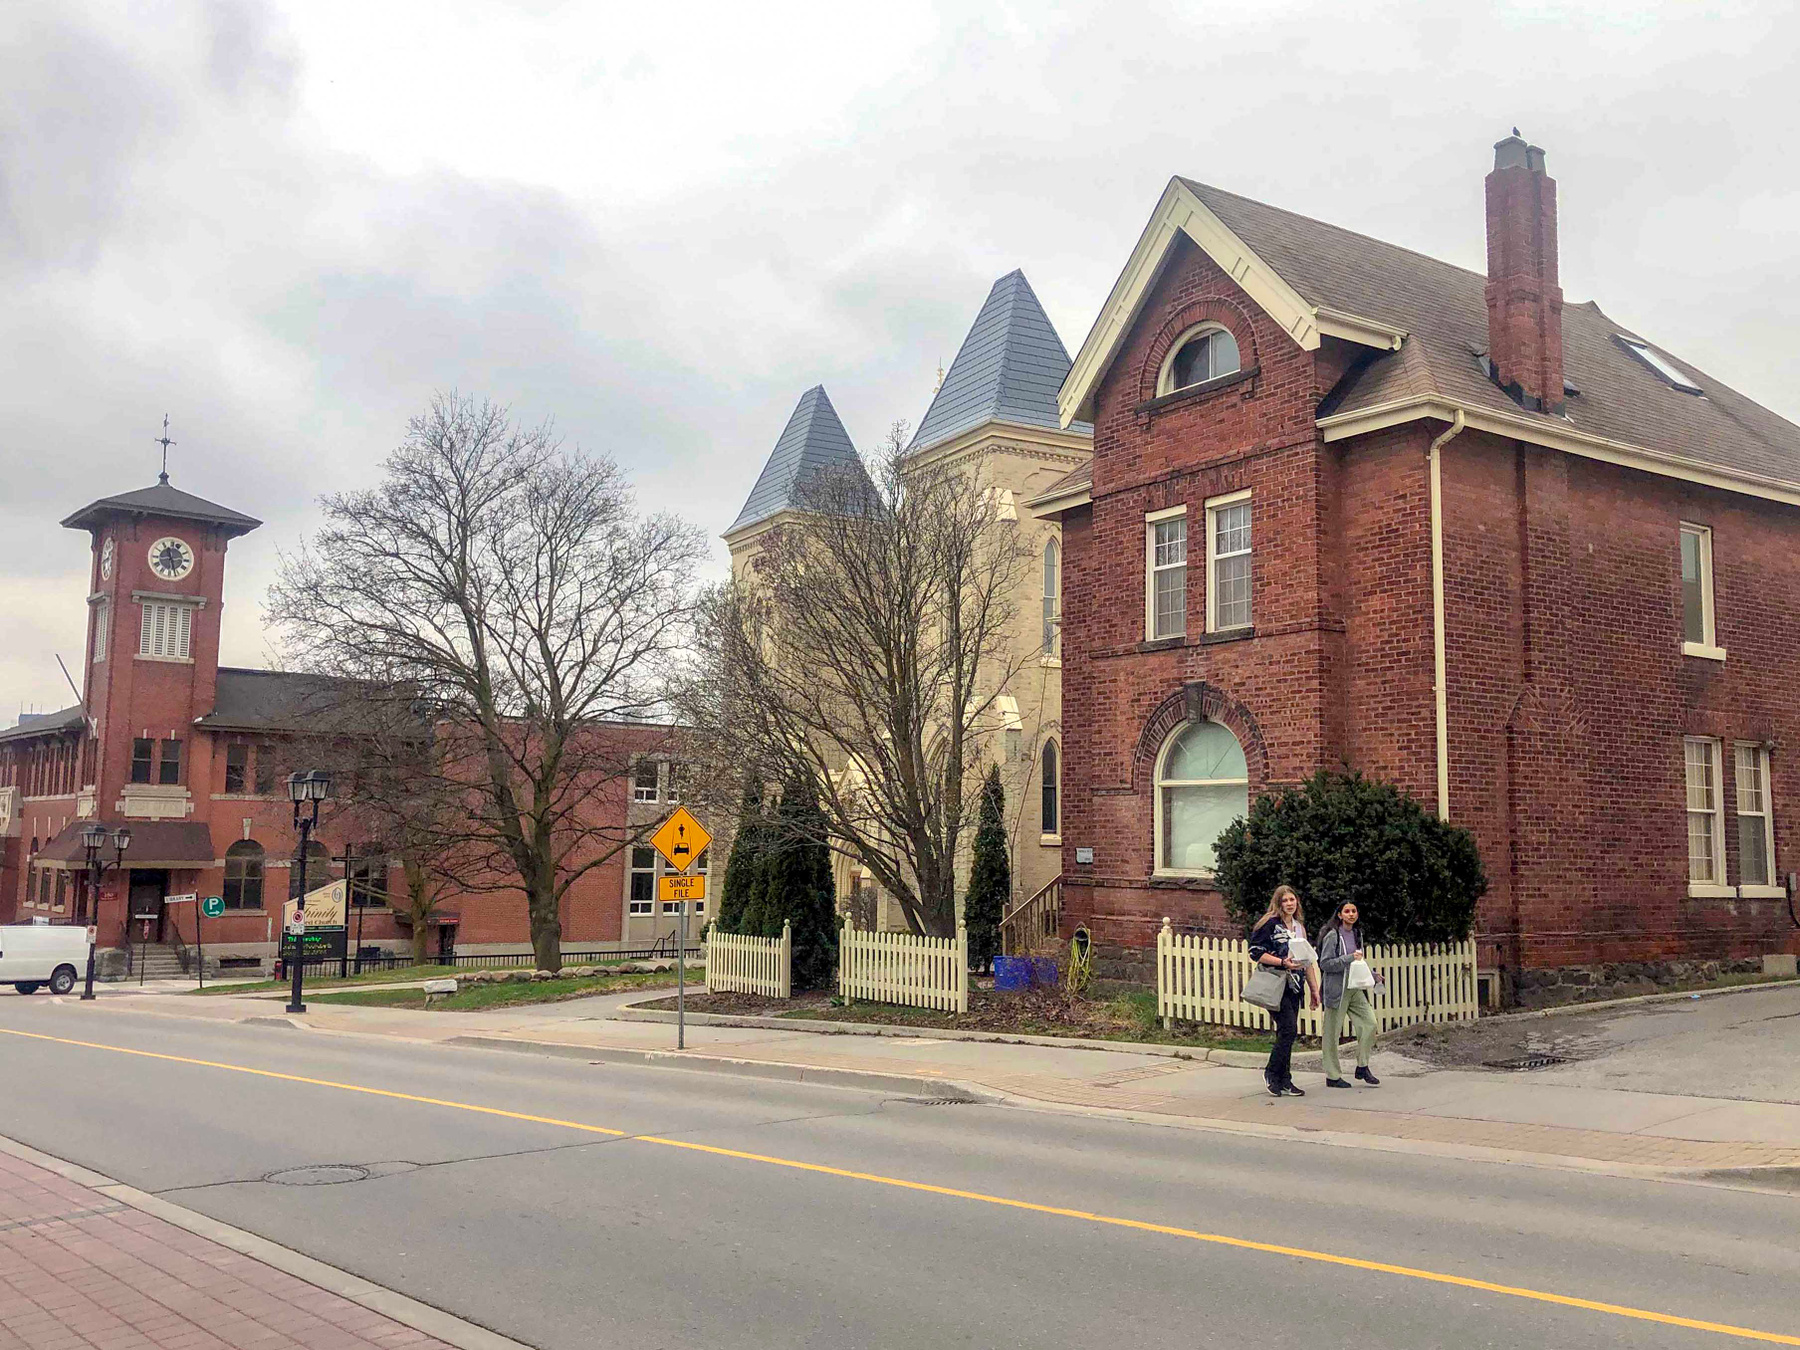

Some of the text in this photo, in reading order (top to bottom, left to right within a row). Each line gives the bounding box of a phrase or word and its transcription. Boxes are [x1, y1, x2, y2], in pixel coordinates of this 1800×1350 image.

[669, 878, 694, 888] SINGLE
[673, 889, 690, 898] FILE
[208, 898, 219, 910] P
[304, 903, 338, 921] Trinity
